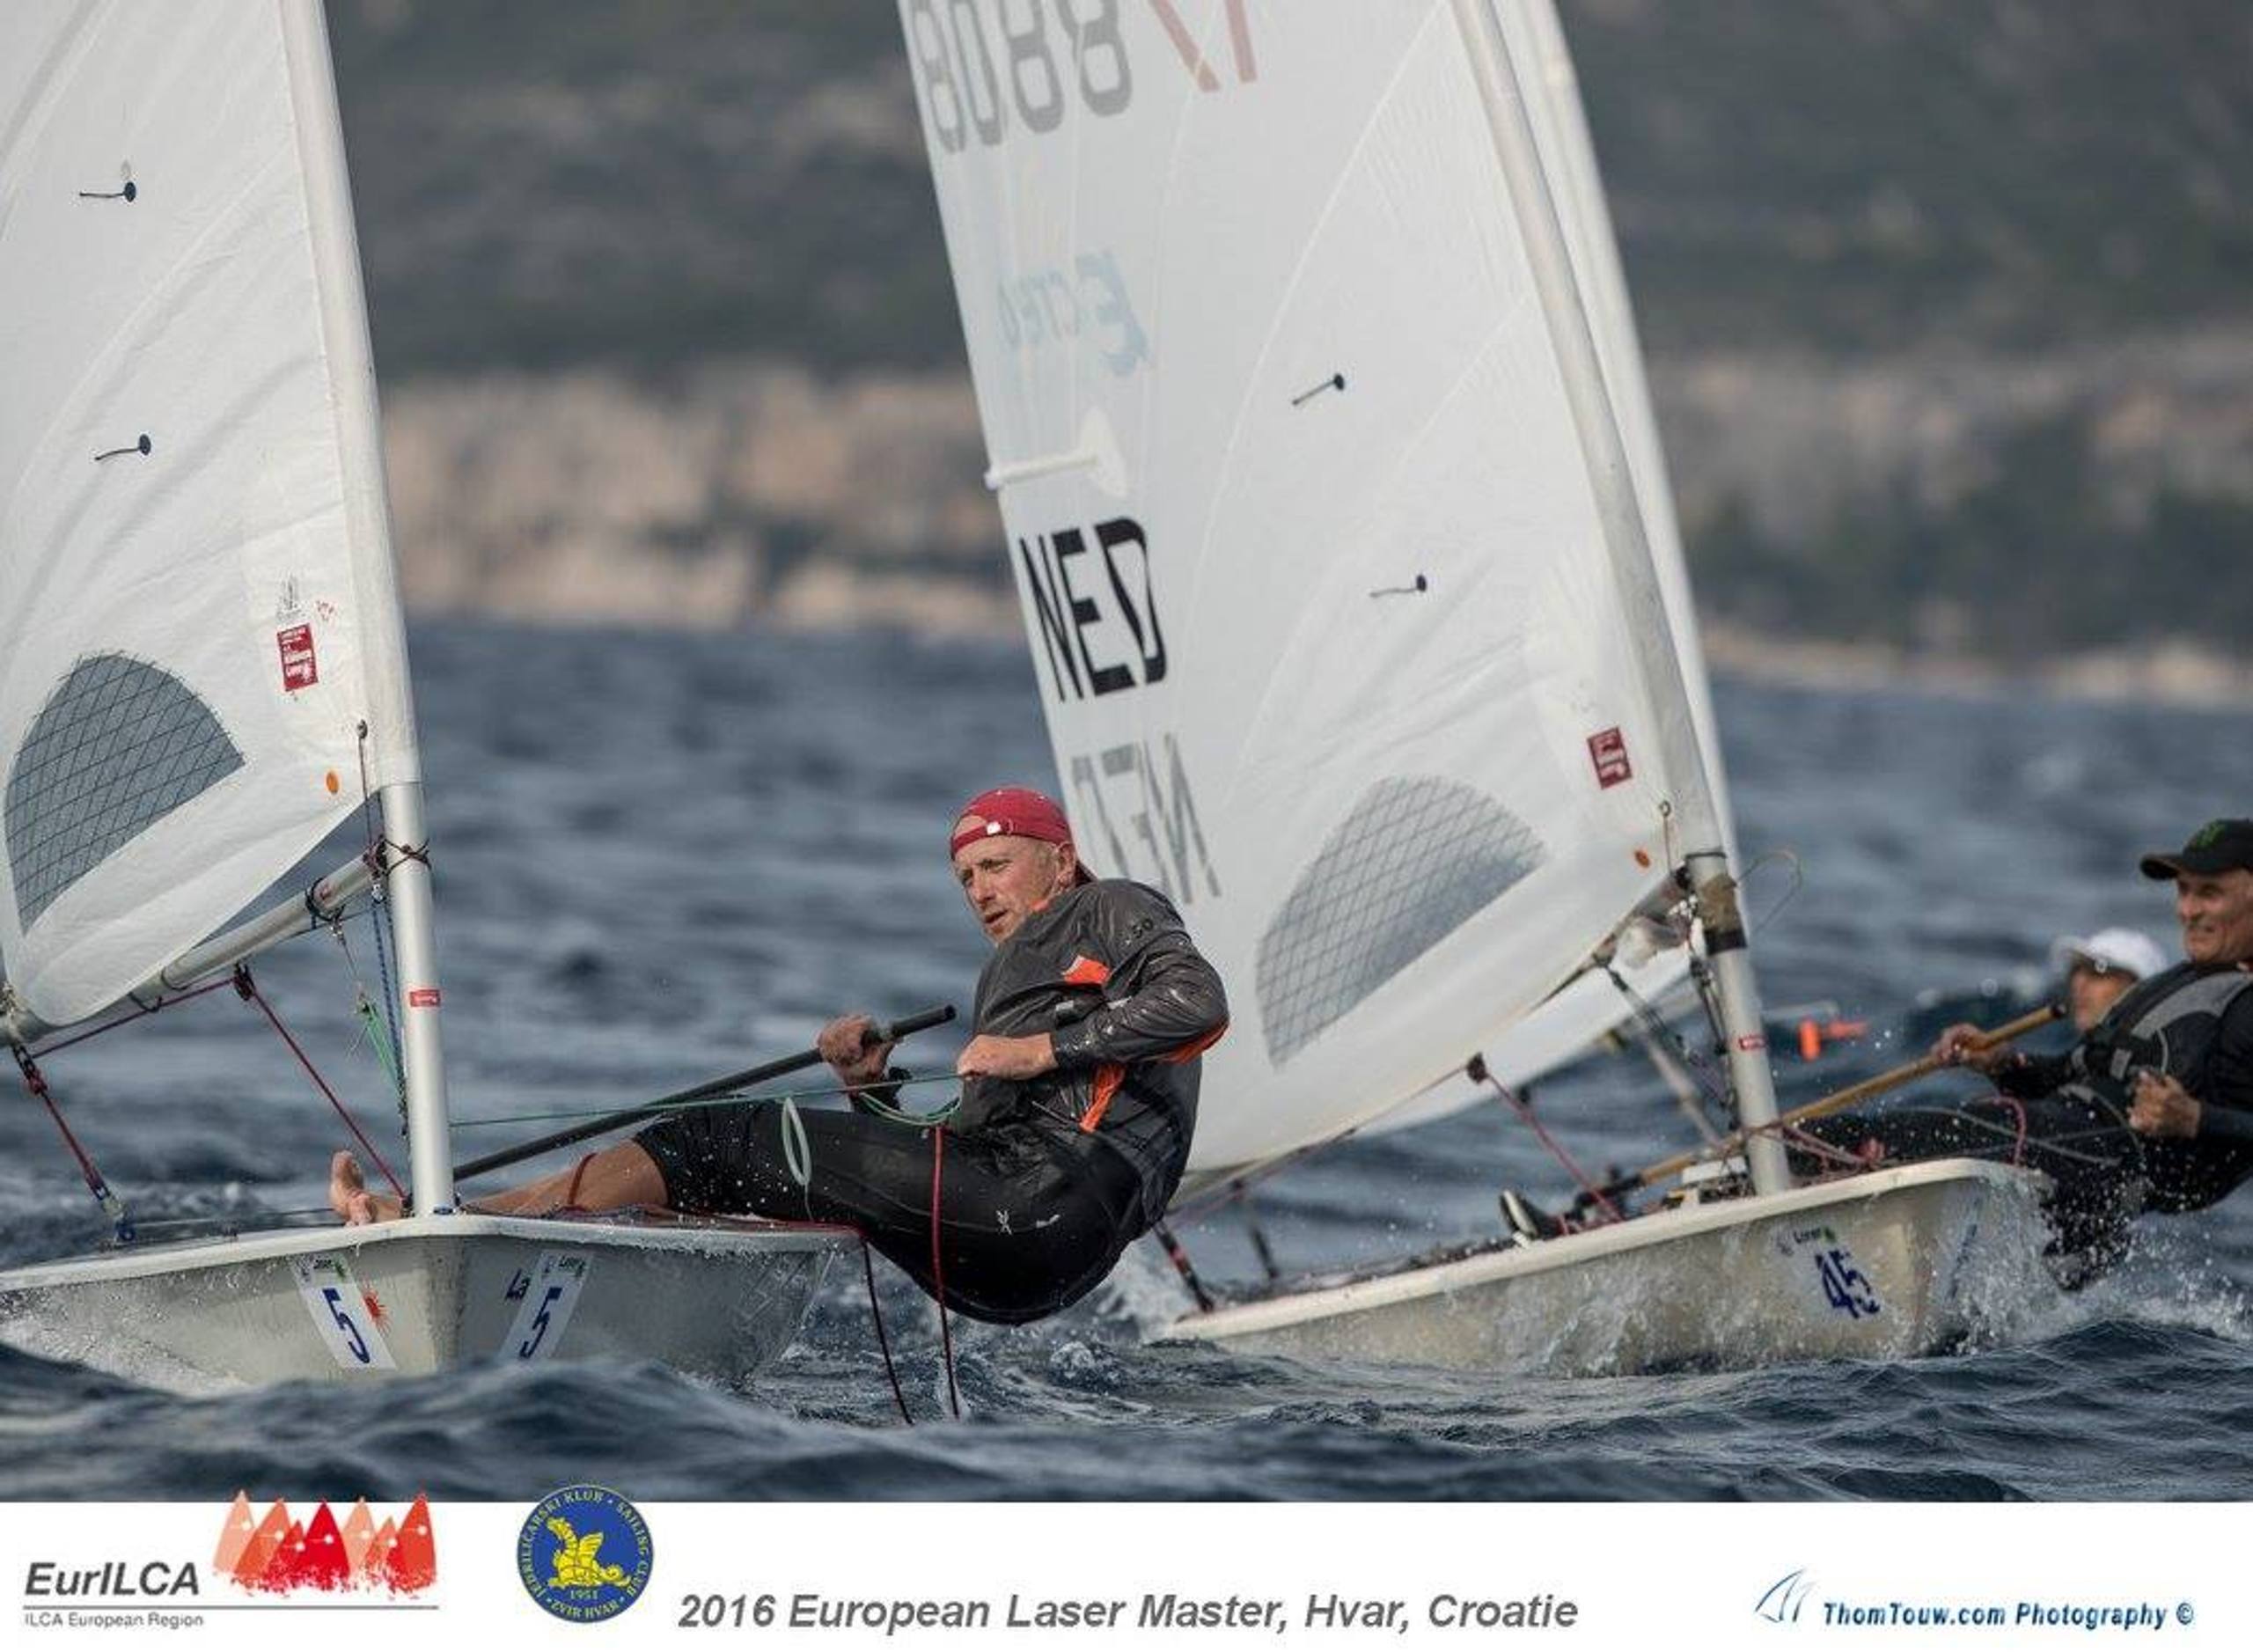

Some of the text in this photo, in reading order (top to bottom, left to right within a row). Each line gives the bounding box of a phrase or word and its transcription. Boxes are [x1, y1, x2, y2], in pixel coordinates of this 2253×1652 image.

[1018, 517, 1168, 702] NED
[1814, 1250, 1881, 1320] 45
[321, 1287, 371, 1364] 5
[518, 1286, 563, 1362] 5
